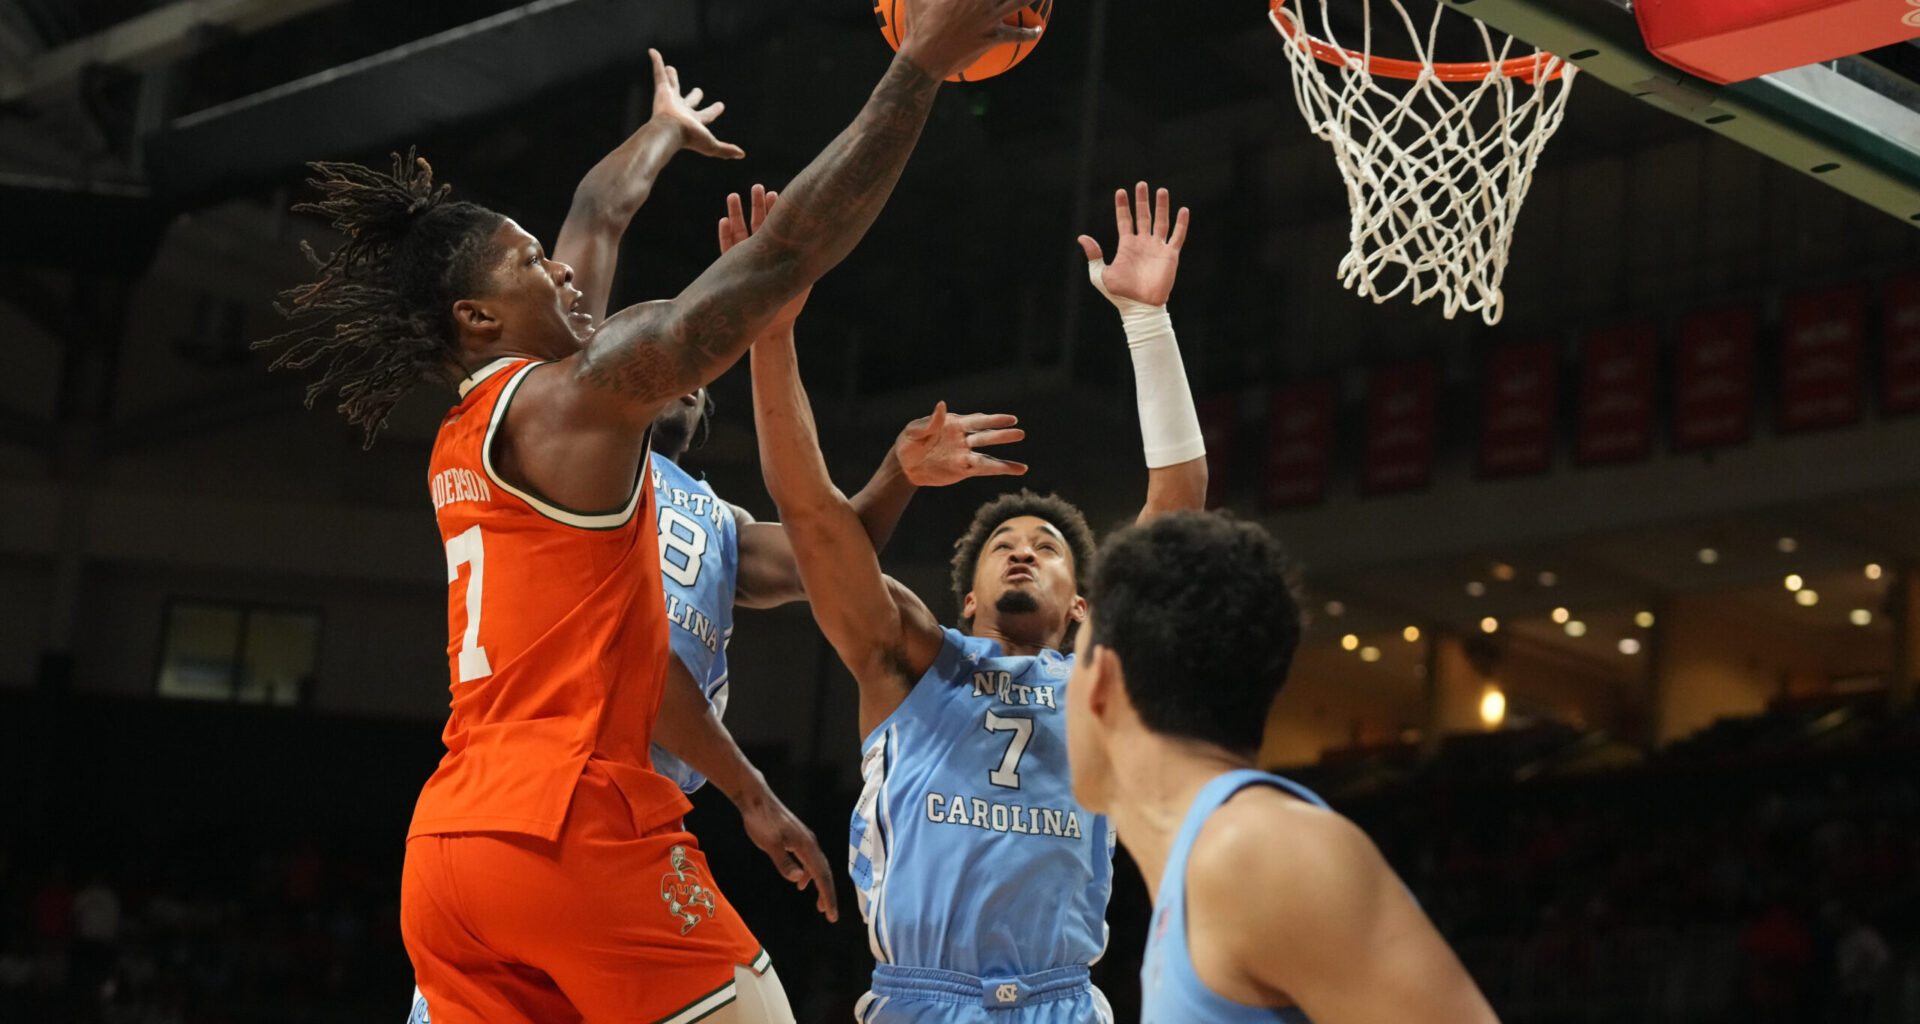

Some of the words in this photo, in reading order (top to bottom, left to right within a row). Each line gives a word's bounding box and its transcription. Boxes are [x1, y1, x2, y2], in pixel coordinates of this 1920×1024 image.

[657, 506, 708, 588] 8
[446, 524, 493, 683] 7
[984, 708, 1034, 789] 7
[926, 793, 1082, 839] CAROLINA
